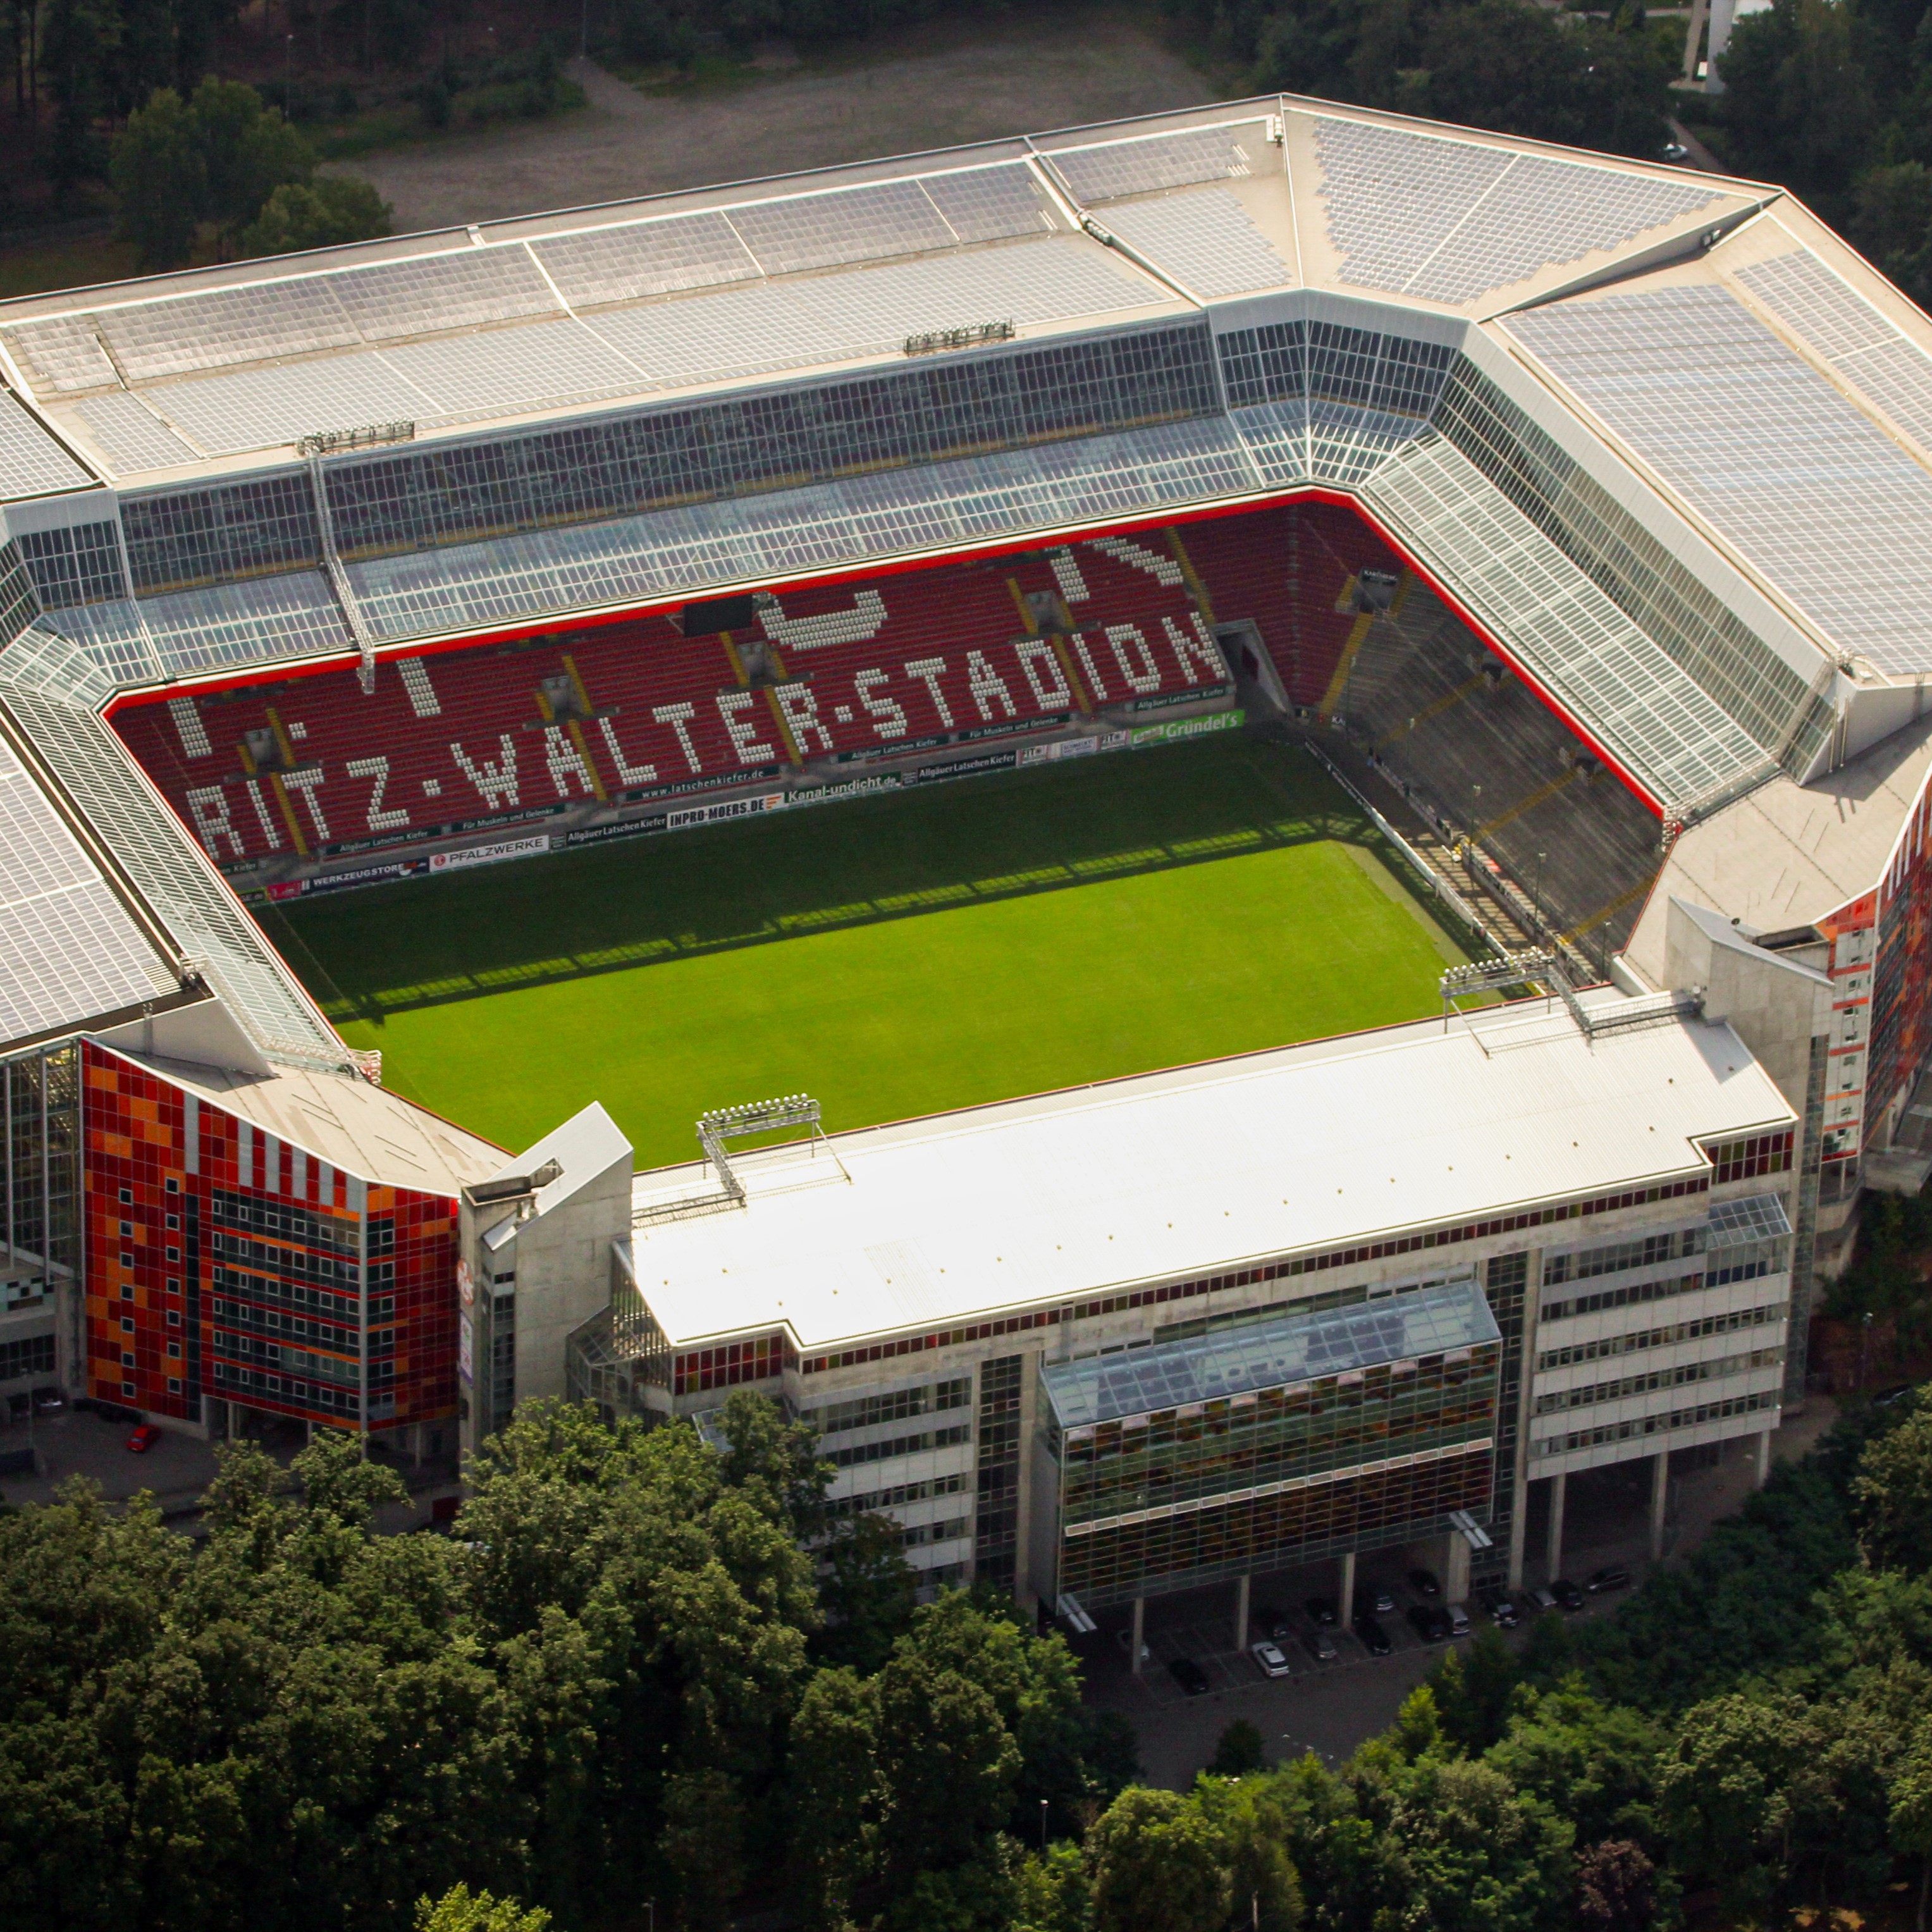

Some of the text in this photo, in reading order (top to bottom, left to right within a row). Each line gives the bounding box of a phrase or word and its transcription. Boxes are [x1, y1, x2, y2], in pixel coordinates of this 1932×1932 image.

[1166, 713, 1238, 738] Gründel's
[919, 754, 1015, 778] Allgäuer Latschen Kiefer
[642, 769, 764, 798] www.latschenkiefer.de
[509, 813, 524, 821] und
[568, 816, 666, 842] Allgäuer Latschen Kiefer
[449, 838, 543, 863] PFALZWERKE
